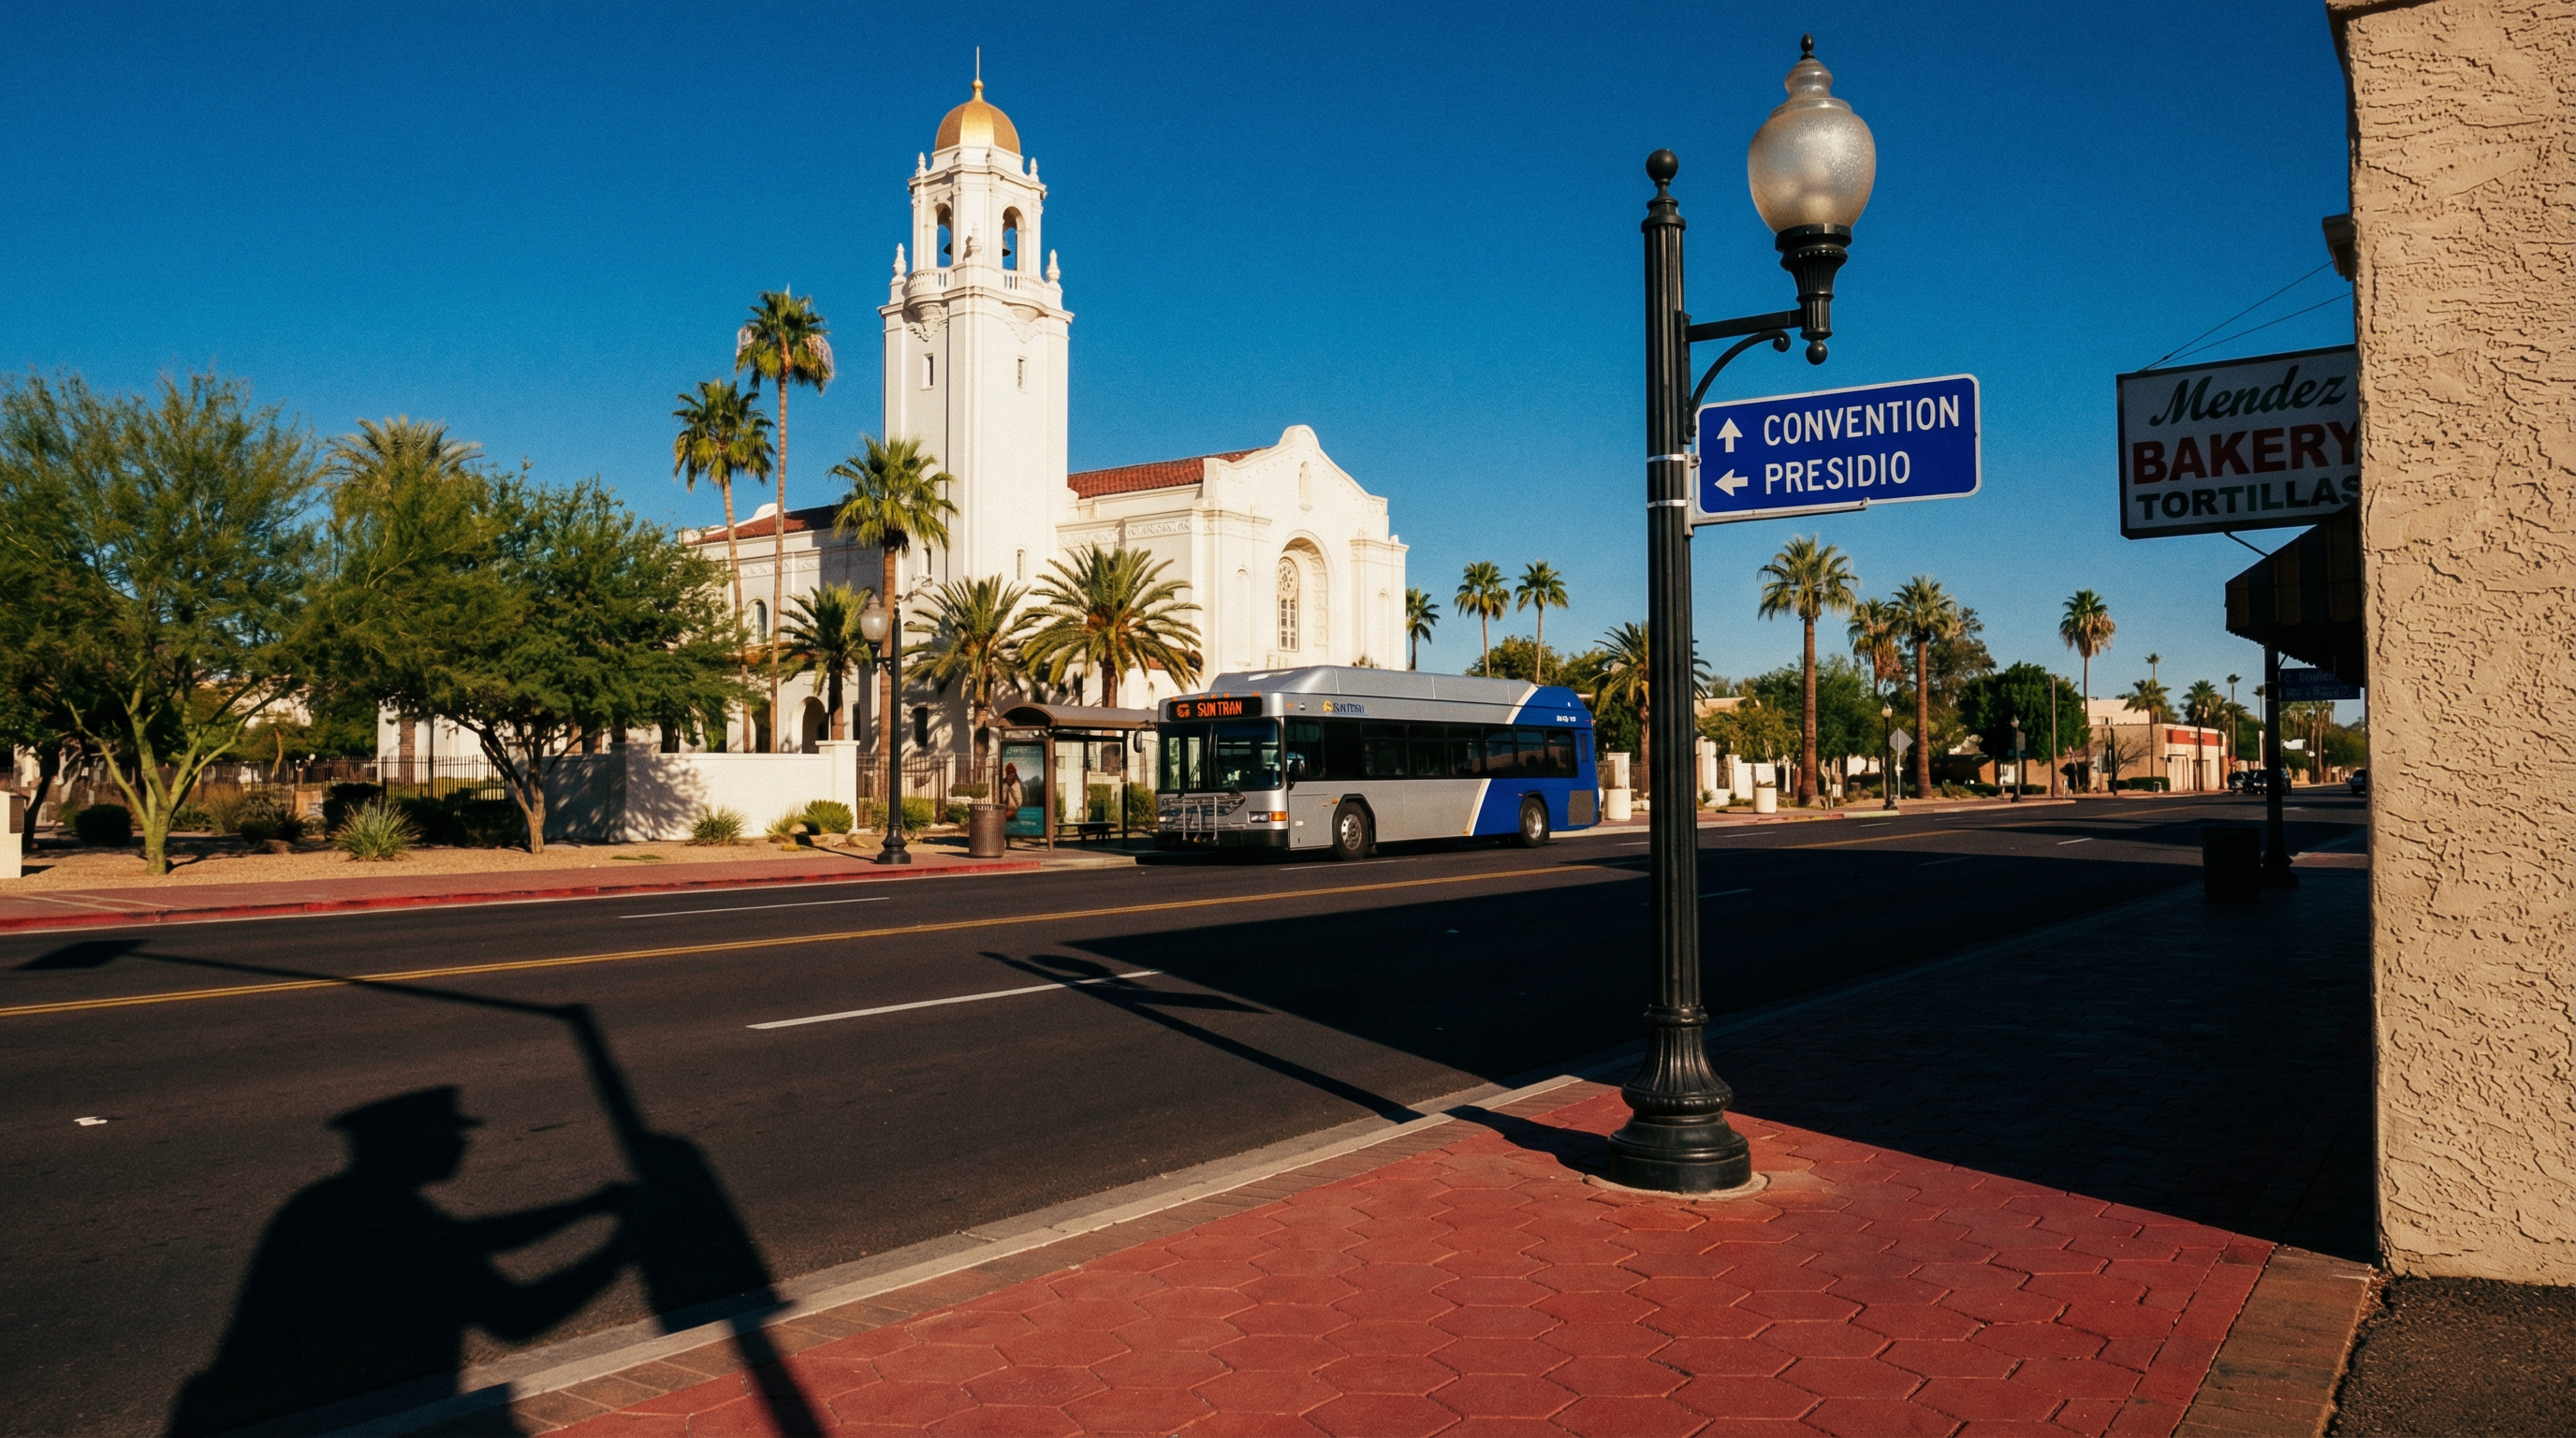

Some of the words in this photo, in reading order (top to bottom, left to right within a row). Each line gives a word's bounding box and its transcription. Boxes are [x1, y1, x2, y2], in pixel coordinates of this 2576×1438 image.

[2149, 364, 2348, 427] Mendez
[1764, 394, 1960, 447] CONVENTION
[1764, 450, 1910, 494] PRESIDIO
[2132, 420, 2357, 485] BAKERY
[2136, 475, 2360, 521] TORTILLAS
[1197, 702, 1216, 717] SUN
[1217, 701, 1242, 716] TRAN
